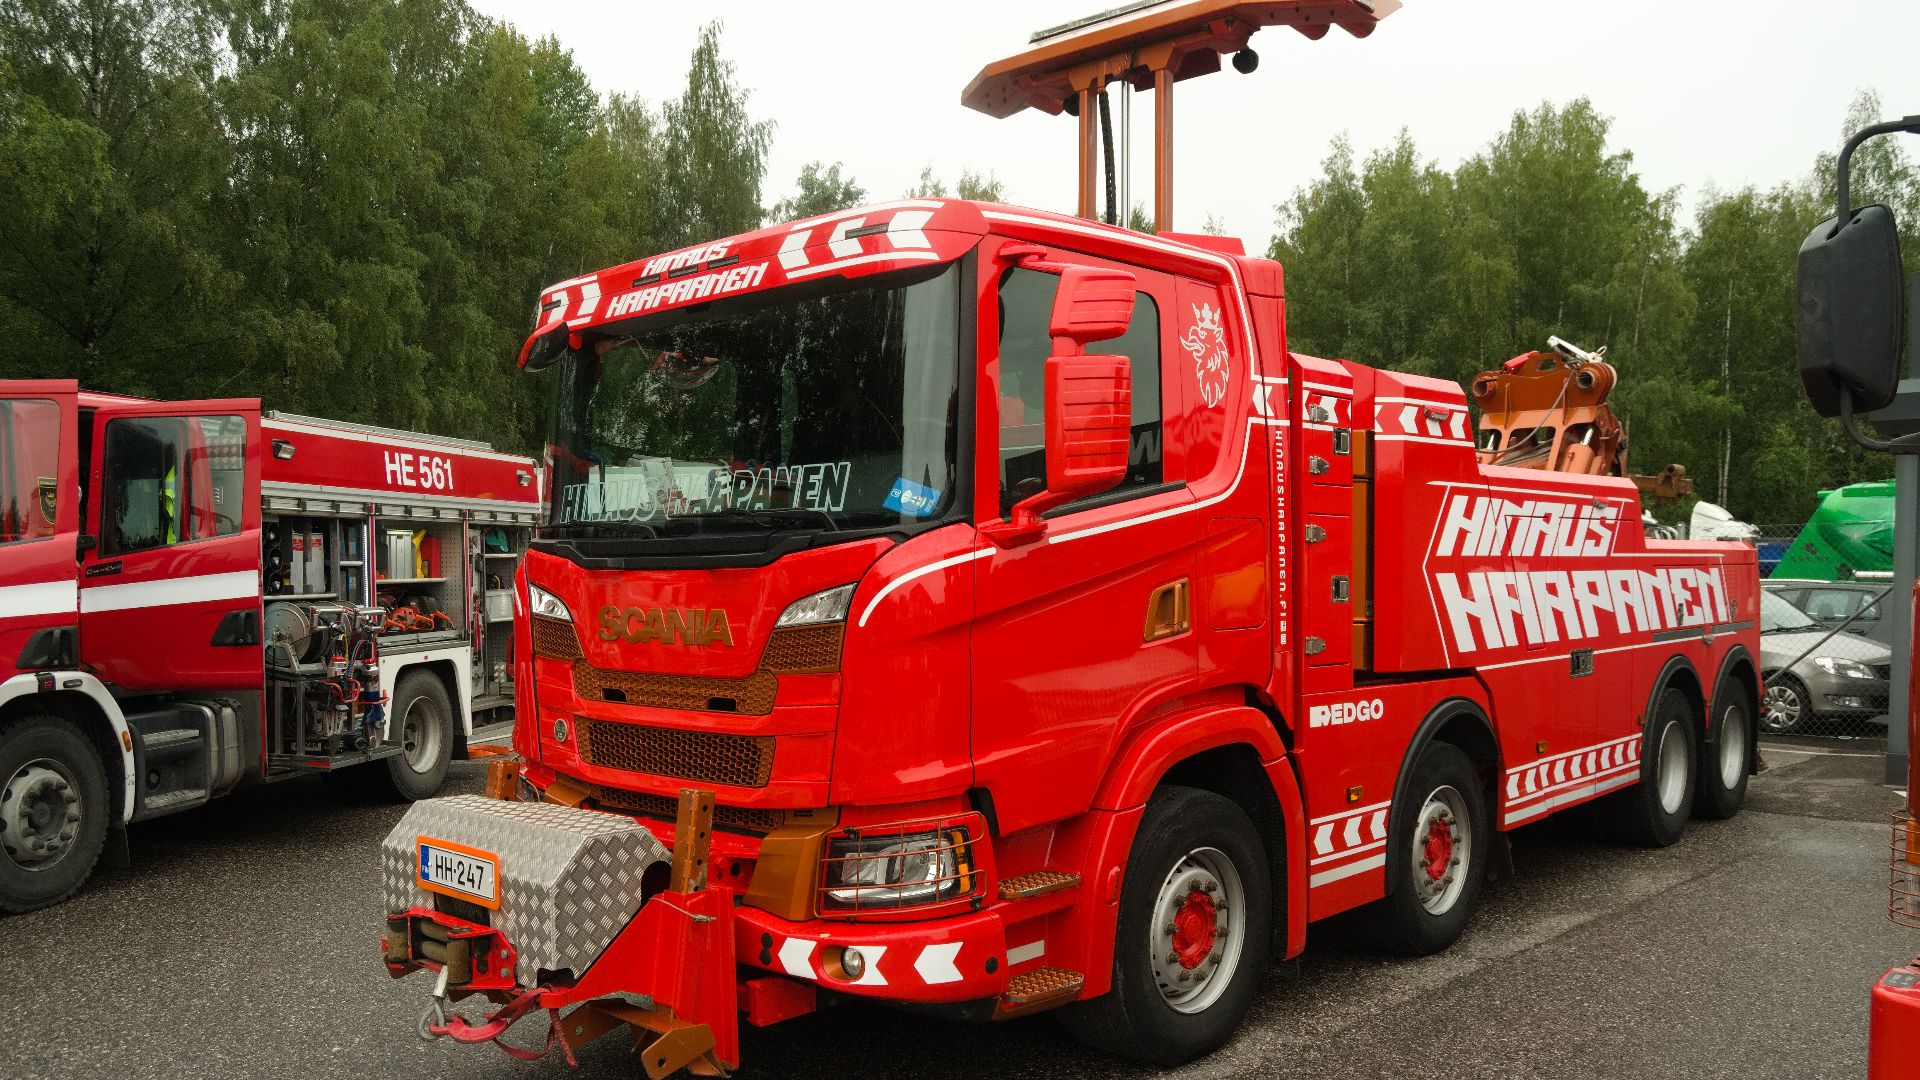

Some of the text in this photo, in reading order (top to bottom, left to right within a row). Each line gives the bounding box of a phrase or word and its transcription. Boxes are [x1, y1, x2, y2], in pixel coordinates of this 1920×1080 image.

[640, 240, 734, 278] HINAUS
[384, 450, 454, 490] HE 561
[1436, 494, 1618, 557] HINAUS
[598, 604, 735, 647] SCANIA
[1435, 567, 1731, 653] HAAPANEN
[1309, 698, 1384, 729] REDGO
[435, 853, 485, 891] HH-247
